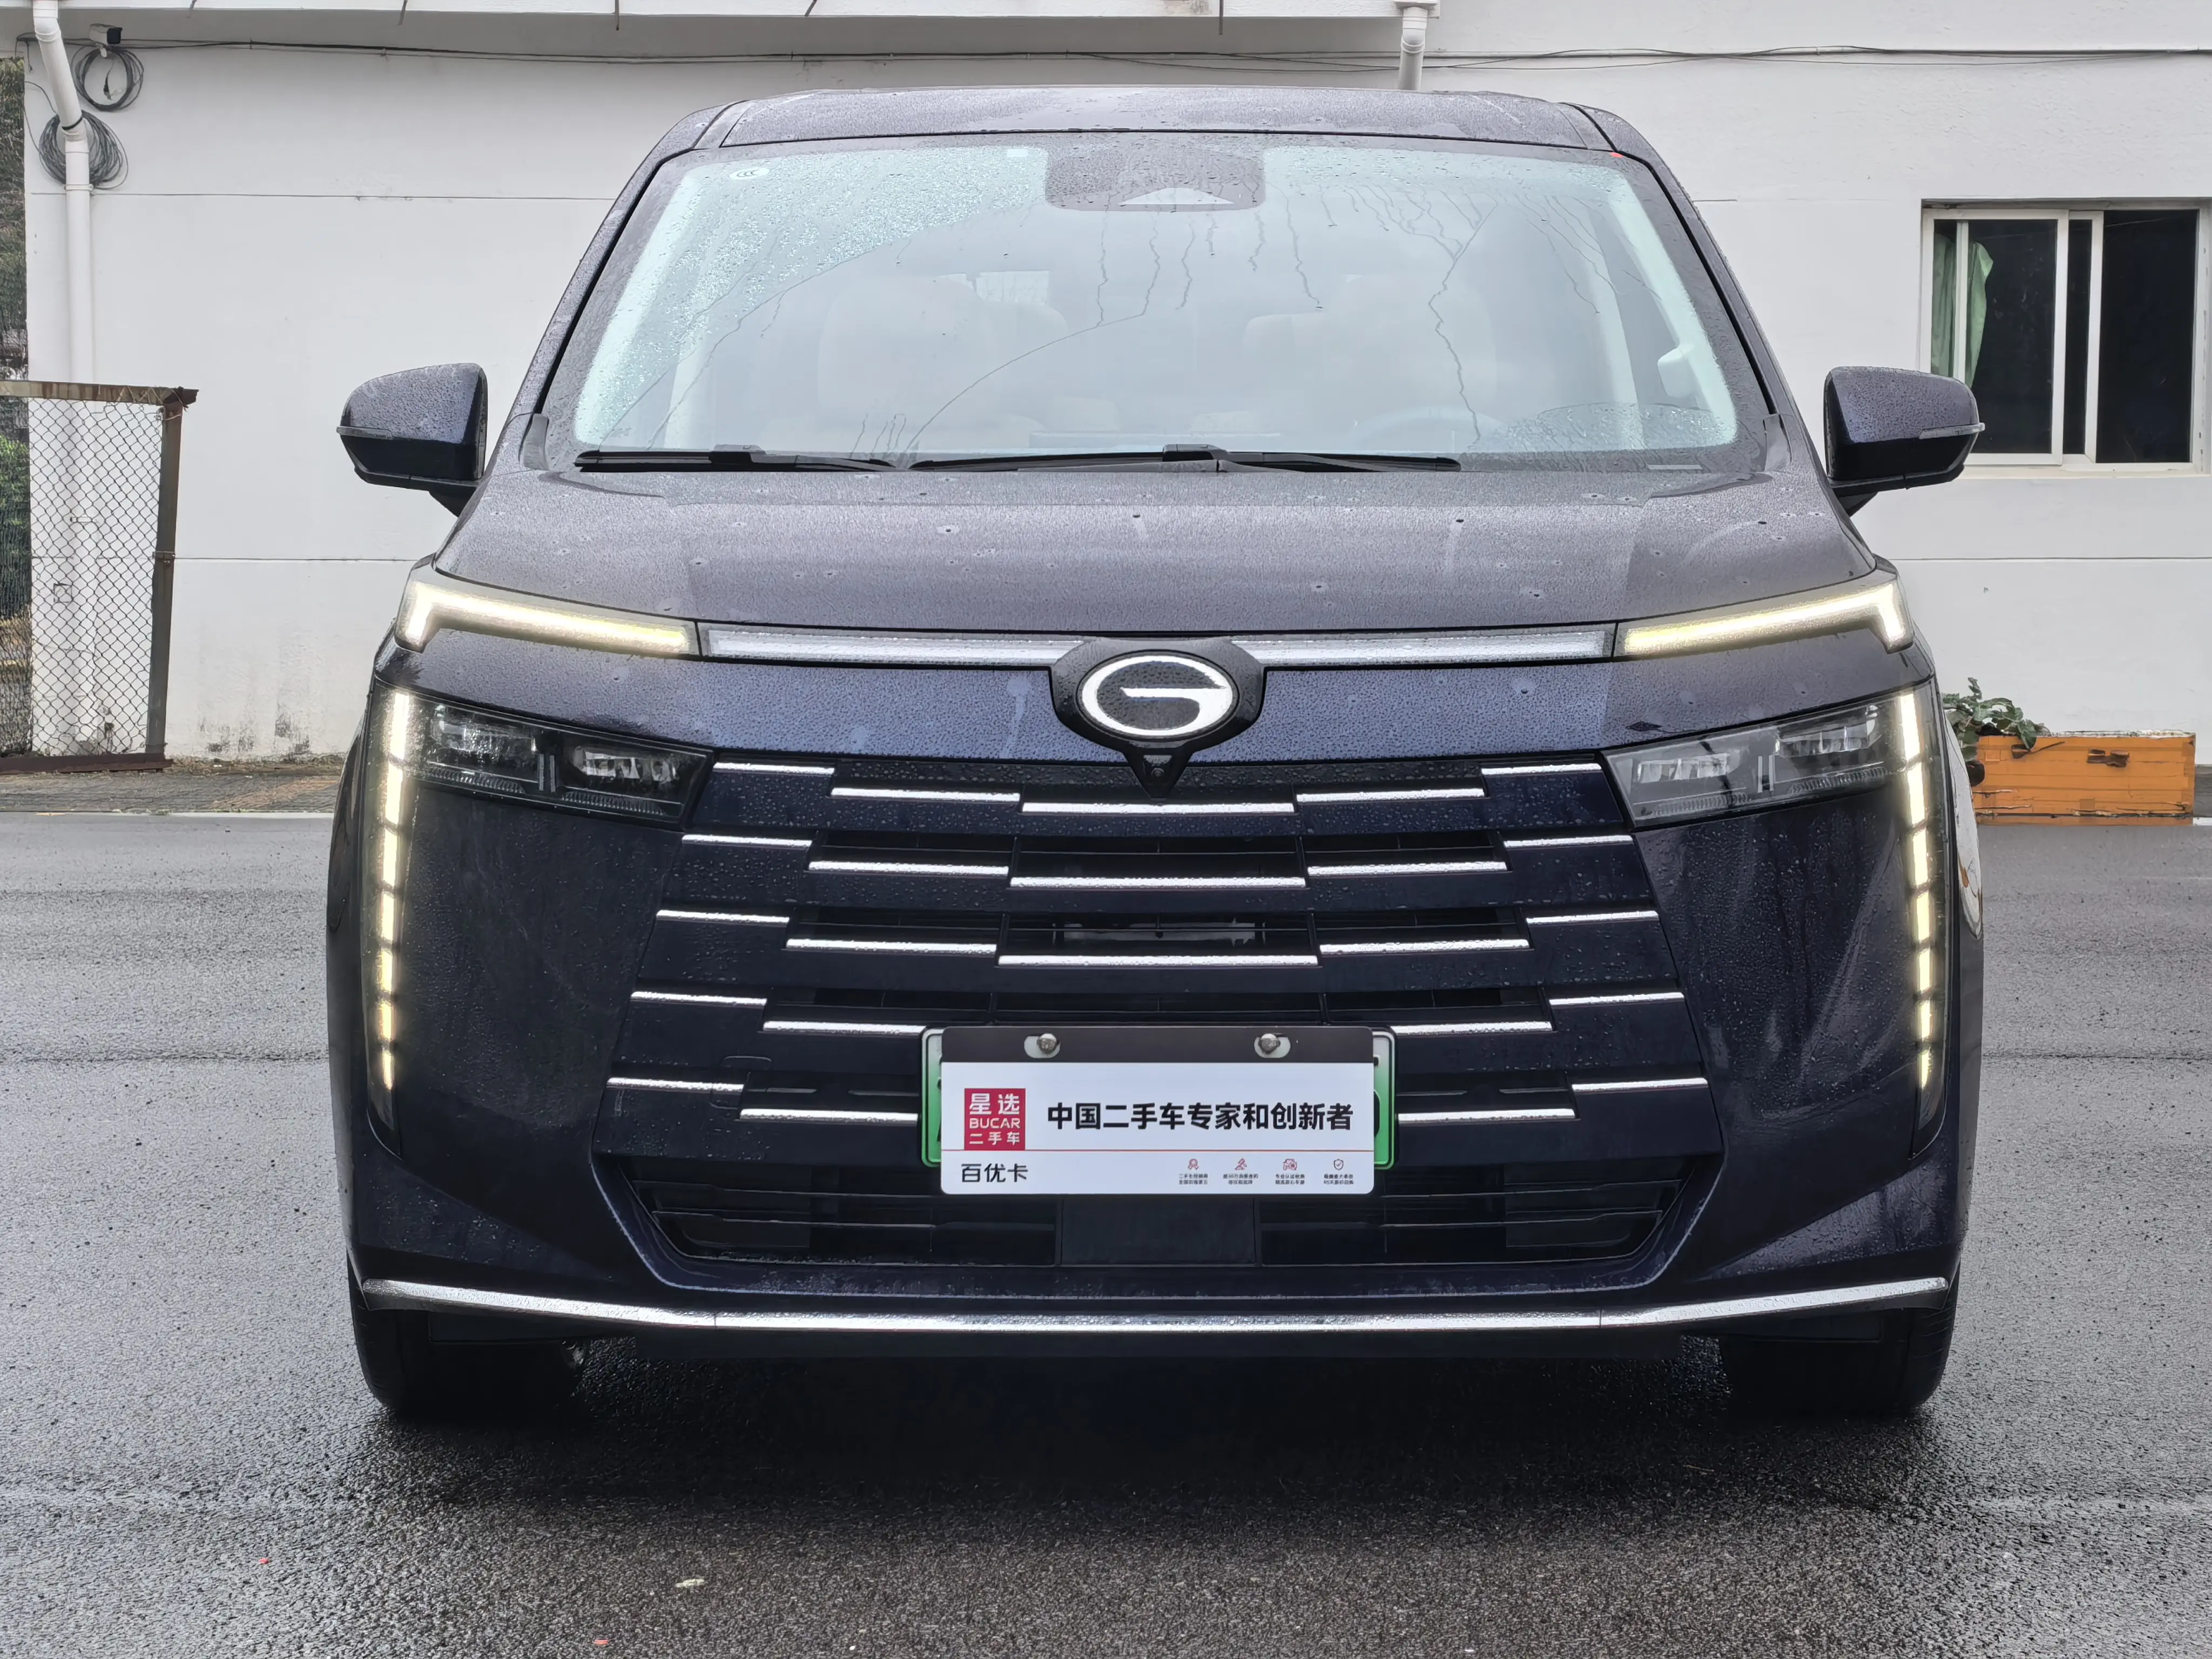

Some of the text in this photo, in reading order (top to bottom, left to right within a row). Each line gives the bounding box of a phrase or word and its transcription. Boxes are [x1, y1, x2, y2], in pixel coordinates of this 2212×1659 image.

[969, 1093, 1020, 1115] 星选
[969, 1118, 1020, 1129] BUCAR
[1048, 1102, 1353, 1130] 中国二手车专家和创新者
[969, 1131, 1020, 1145] 二手车
[961, 1163, 1028, 1183] 百优卡
